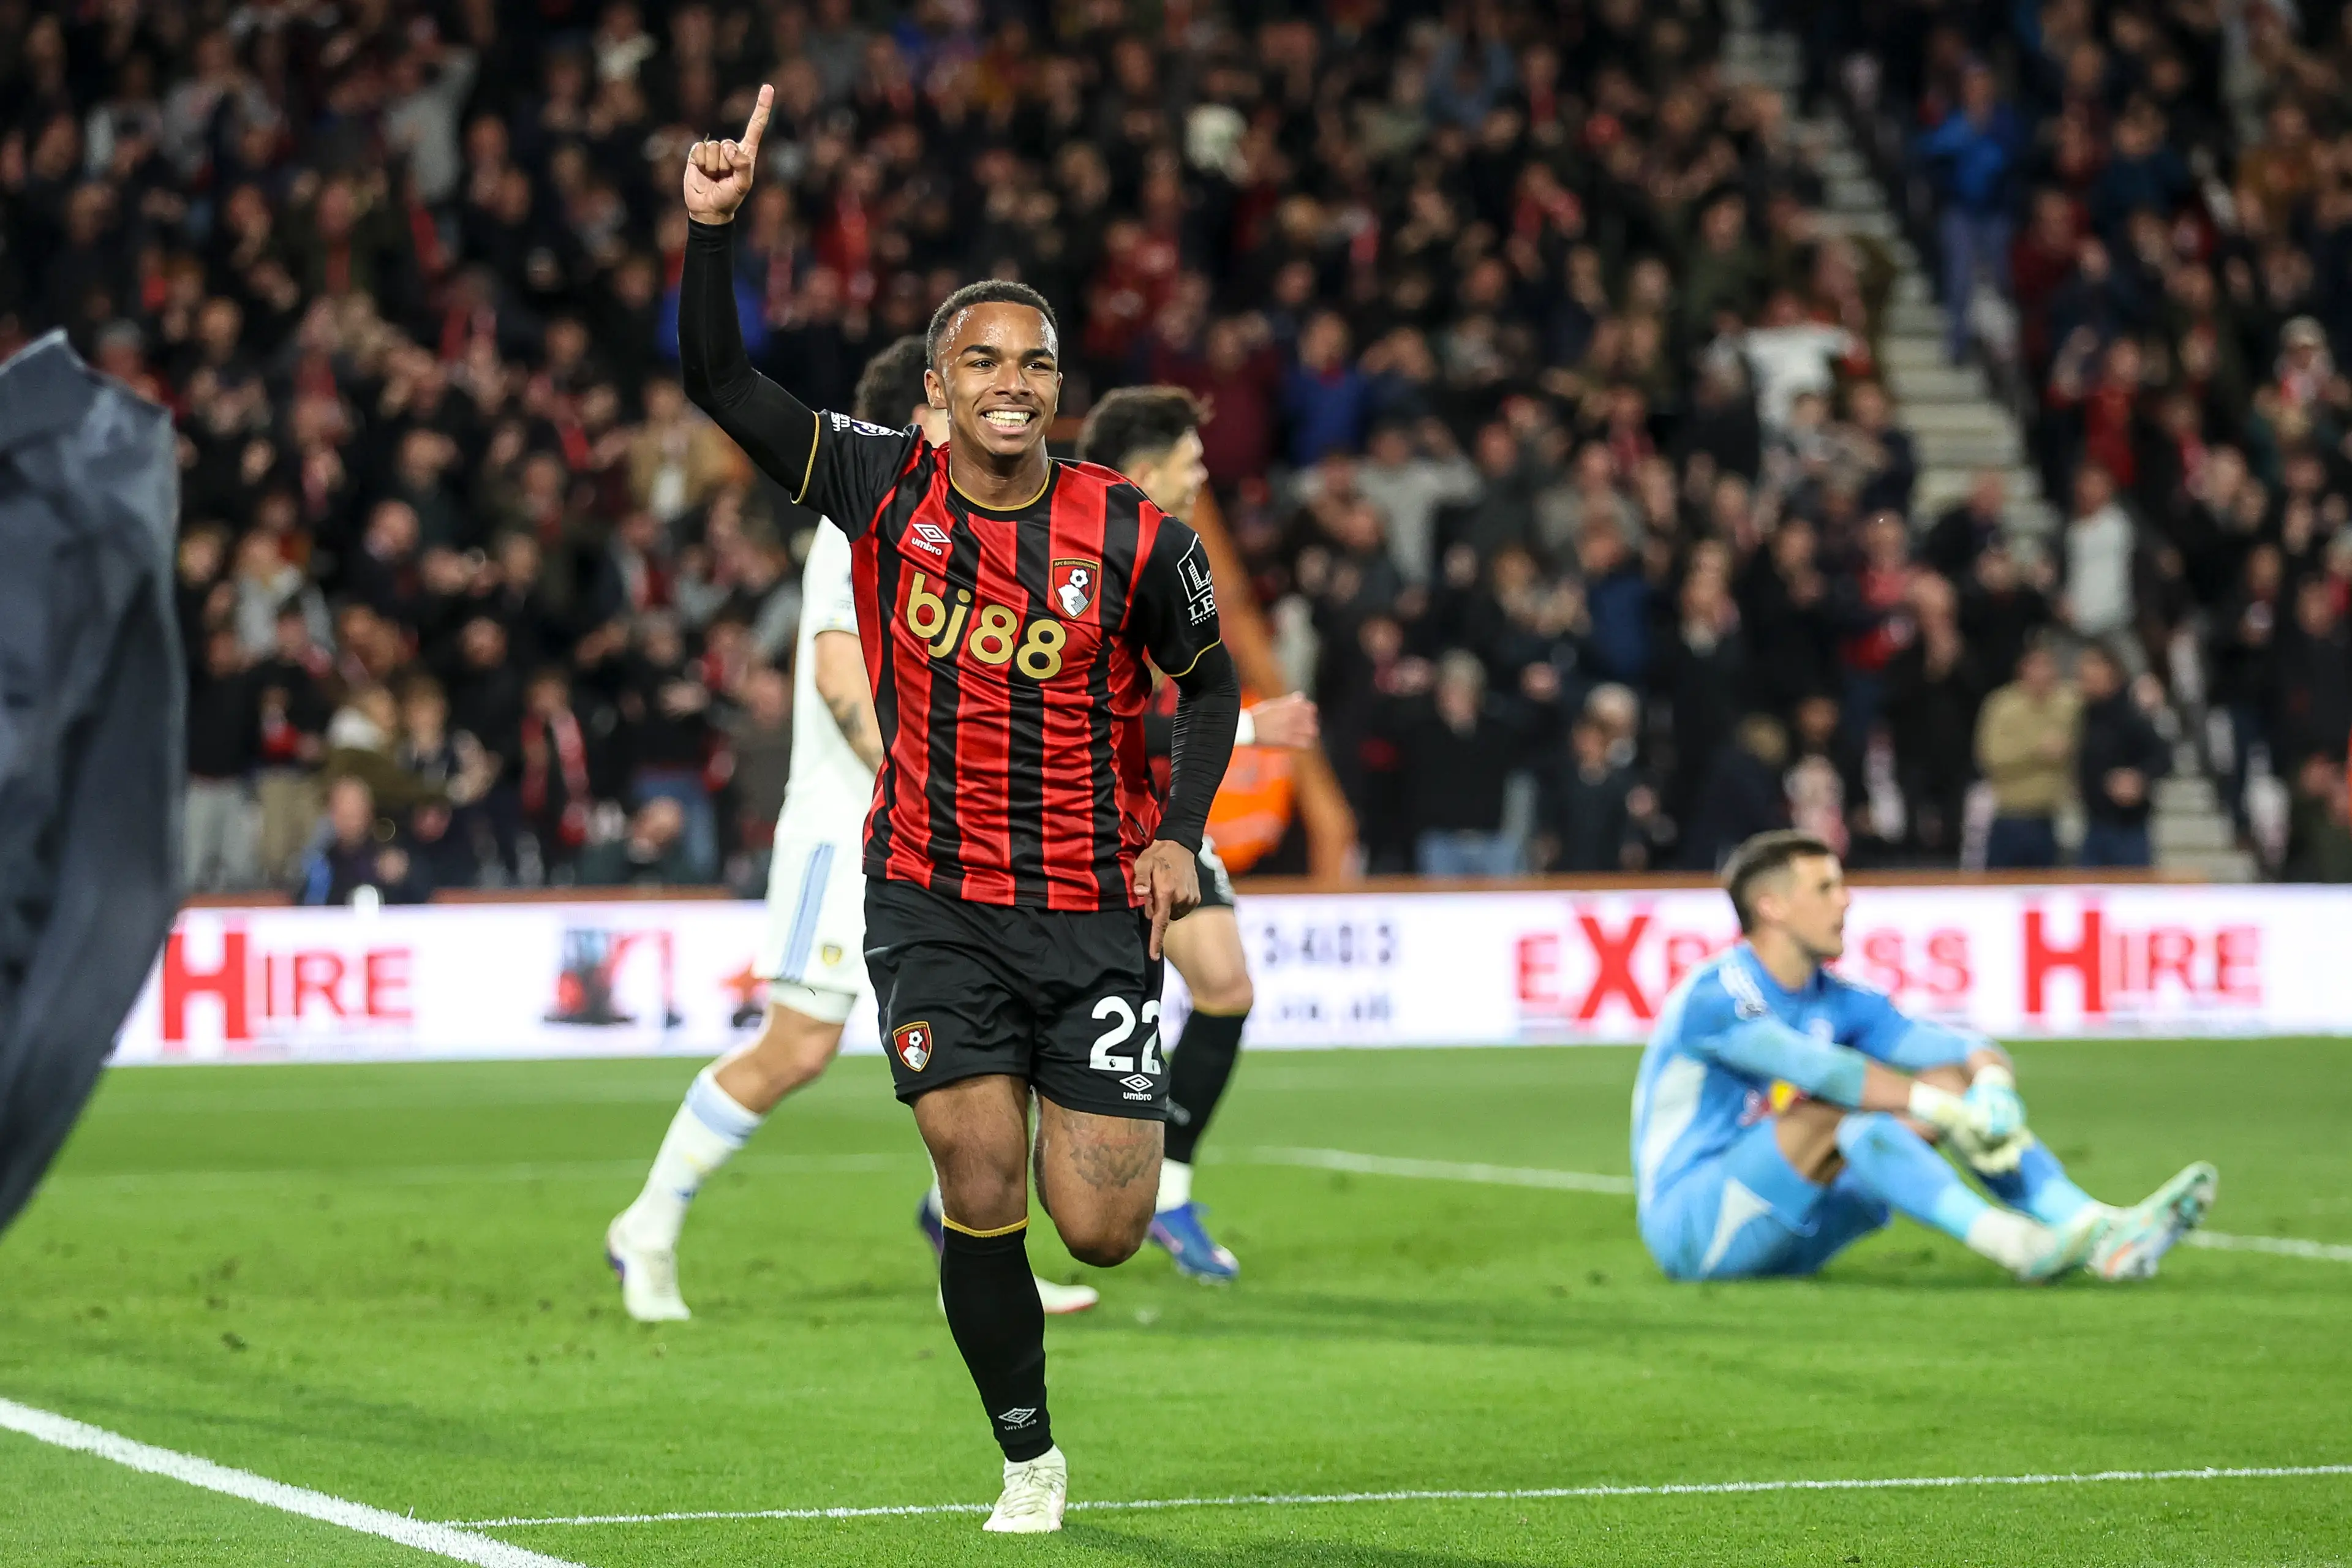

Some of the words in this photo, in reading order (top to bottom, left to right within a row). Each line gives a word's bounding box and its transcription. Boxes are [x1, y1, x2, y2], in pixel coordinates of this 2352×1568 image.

[911, 537, 942, 556] umbro
[907, 571, 1066, 679] bj88
[1187, 594, 1217, 622] LE
[162, 932, 413, 1041] HIRE
[2023, 909, 2261, 1014] HIRE
[1089, 995, 1161, 1075] 22
[1123, 1091, 1152, 1101] umbro
[1005, 1419, 1037, 1430] umbro
